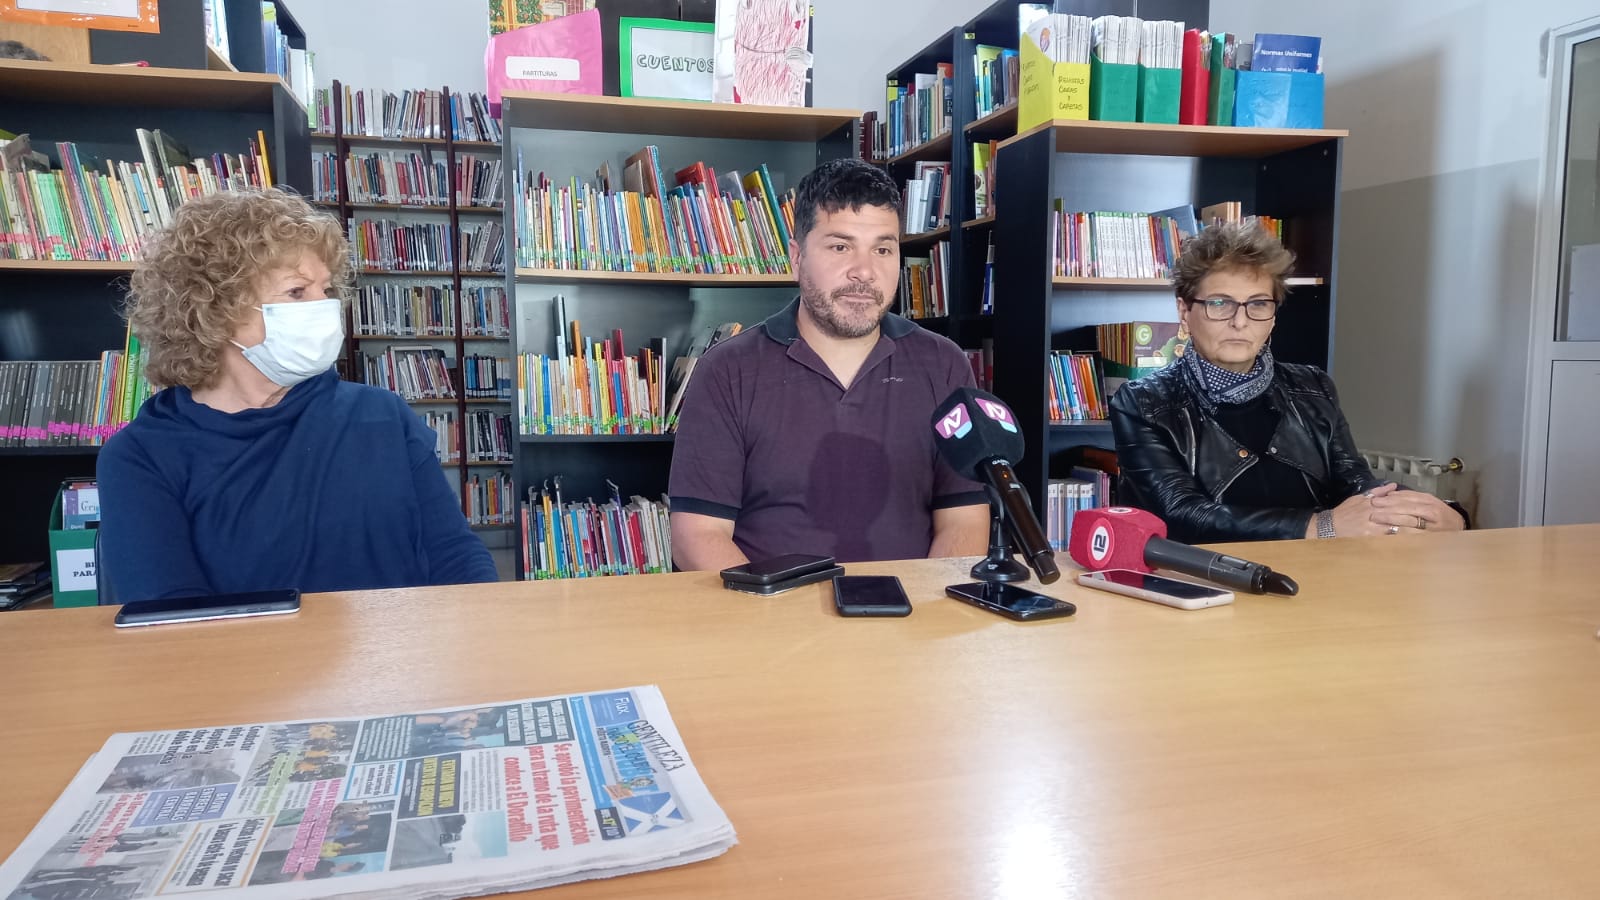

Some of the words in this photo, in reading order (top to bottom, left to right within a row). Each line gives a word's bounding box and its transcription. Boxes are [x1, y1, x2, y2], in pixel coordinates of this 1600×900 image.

[637, 54, 714, 72] CUENTOS
[614, 697, 630, 713] Flux
[240, 725, 263, 750] Conductor
[628, 720, 686, 772] GENTILEZA
[527, 745, 544, 760] para
[554, 743, 570, 751] Se
[504, 757, 522, 785] conduce
[531, 761, 545, 769] un
[554, 752, 576, 776] aprobó
[533, 770, 550, 791] tramo
[507, 792, 527, 800] El
[535, 792, 554, 803] de
[536, 804, 555, 814] la
[560, 785, 592, 844] pavimentación
[507, 801, 532, 841] Doradillo
[538, 814, 558, 832] ruta
[538, 834, 559, 850] que
